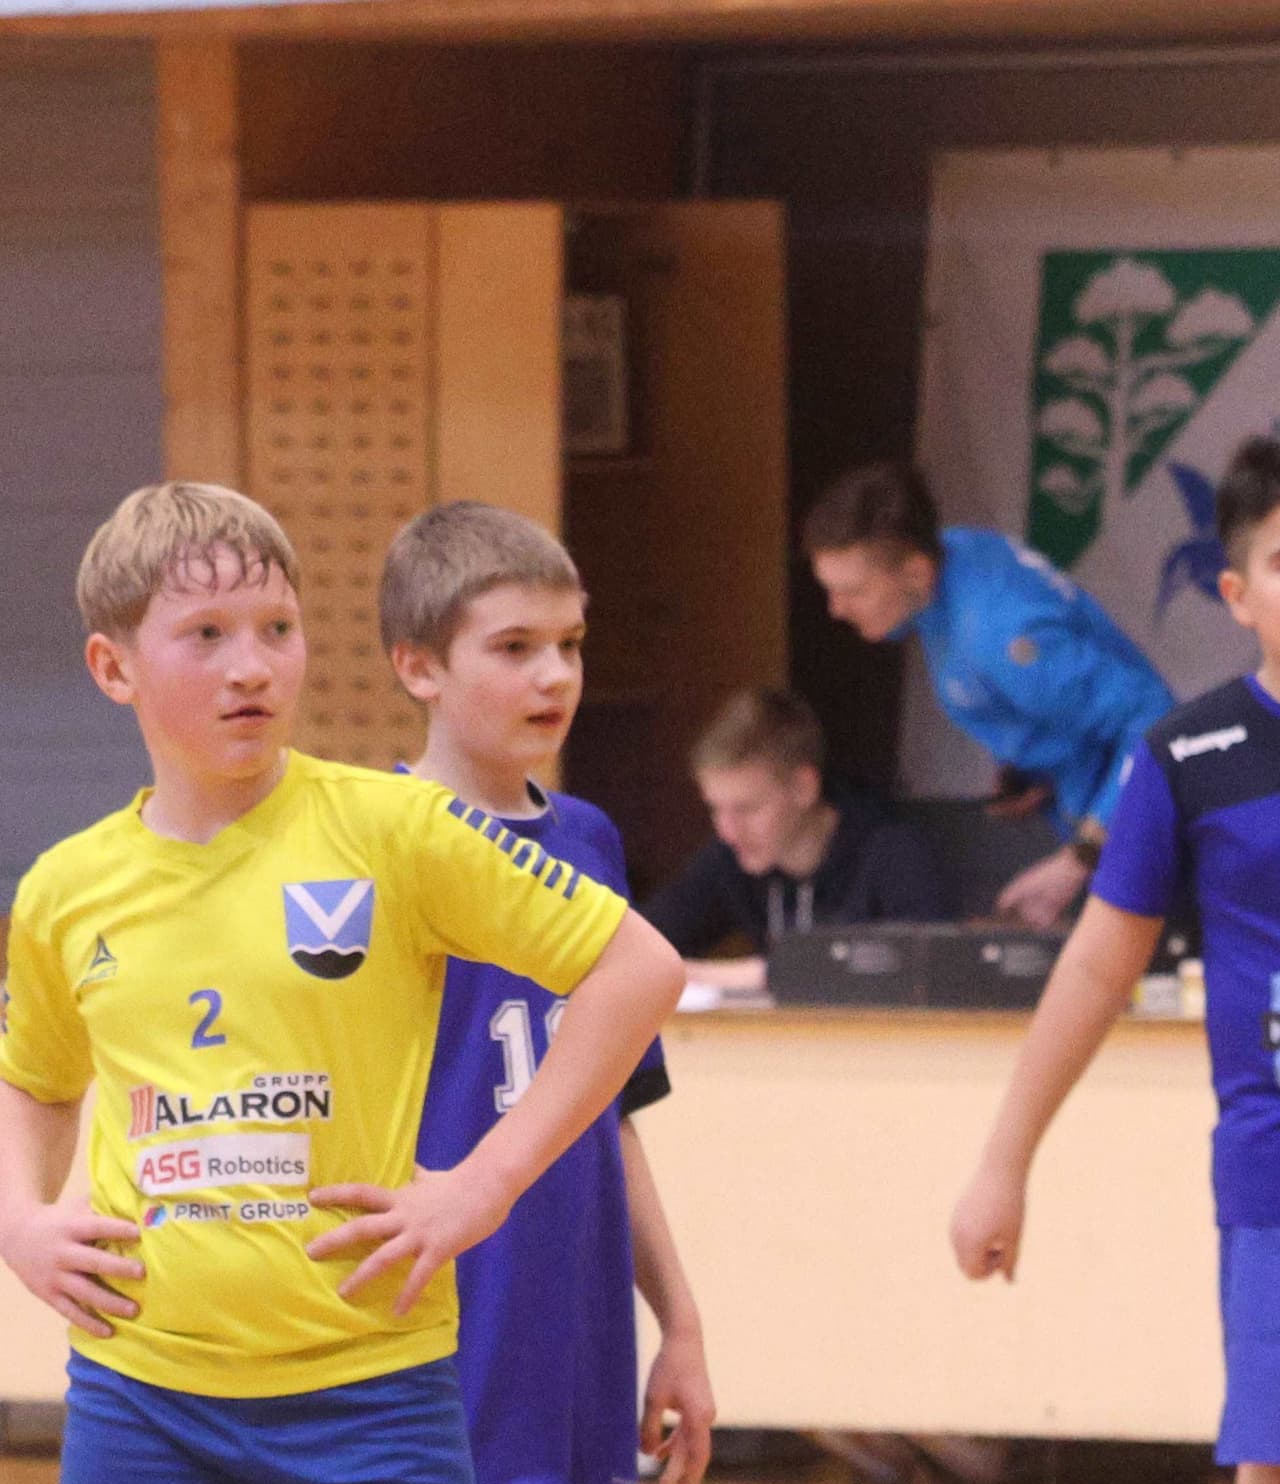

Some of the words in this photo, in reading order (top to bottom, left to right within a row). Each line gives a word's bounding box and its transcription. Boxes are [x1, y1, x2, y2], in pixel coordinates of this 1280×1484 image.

[188, 988, 227, 1049] 2
[489, 998, 570, 1114] 1
[253, 1074, 330, 1088] GRUPP
[155, 1090, 331, 1130] ALARON
[139, 1150, 201, 1188] ASG
[208, 1156, 305, 1177] Robotics
[174, 1203, 231, 1220] PRINT
[240, 1203, 309, 1220] GRUPP
